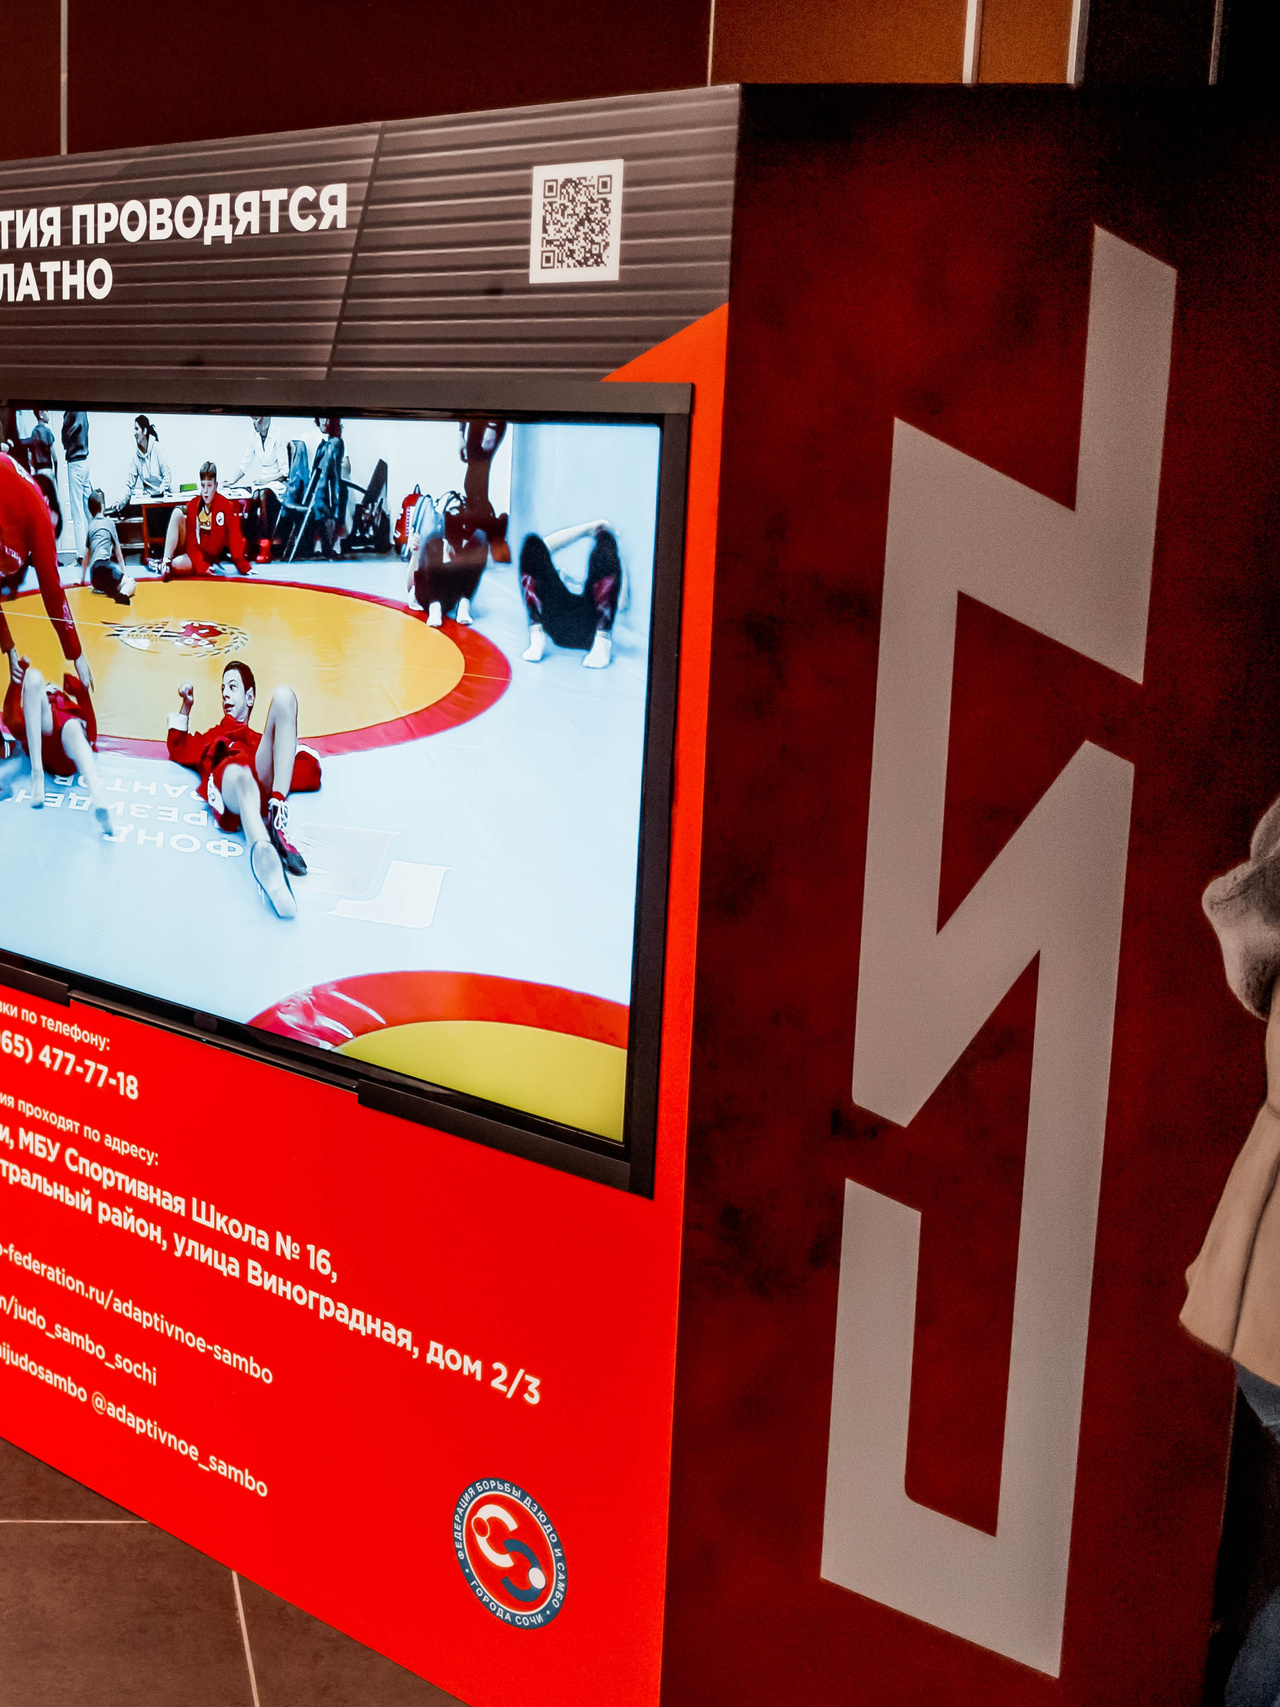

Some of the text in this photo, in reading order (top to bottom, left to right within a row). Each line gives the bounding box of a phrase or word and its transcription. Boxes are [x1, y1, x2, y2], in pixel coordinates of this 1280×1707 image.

[71, 183, 348, 246] ПРОВОДЯТСЯ
[21, 1006, 38, 1025] по
[40, 1014, 111, 1052] телефону:
[38, 1045, 140, 1101] 477-77-18
[18, 1098, 81, 1137] проходят
[83, 1124, 101, 1143] по
[104, 1132, 159, 1166] адресу:
[18, 1126, 60, 1164] МБУ
[64, 1147, 186, 1217] Спортивная
[191, 1196, 270, 1253] Школа
[275, 1230, 301, 1262] №
[306, 1243, 339, 1285] 16,
[97, 1199, 168, 1251] район,
[172, 1231, 241, 1279] улица
[246, 1258, 420, 1360] Виноградная,
[425, 1339, 483, 1383] дом
[489, 1361, 542, 1406] 2/3
[91, 1391, 269, 1498] @adaptivnoe_sambo
[453, 1479, 566, 1608] ФЕДЕРАЦИЯ БОРЬБЫ ДЗЮДО И САМБО
[470, 1580, 544, 1627] ГОРОДА СОЧИ
